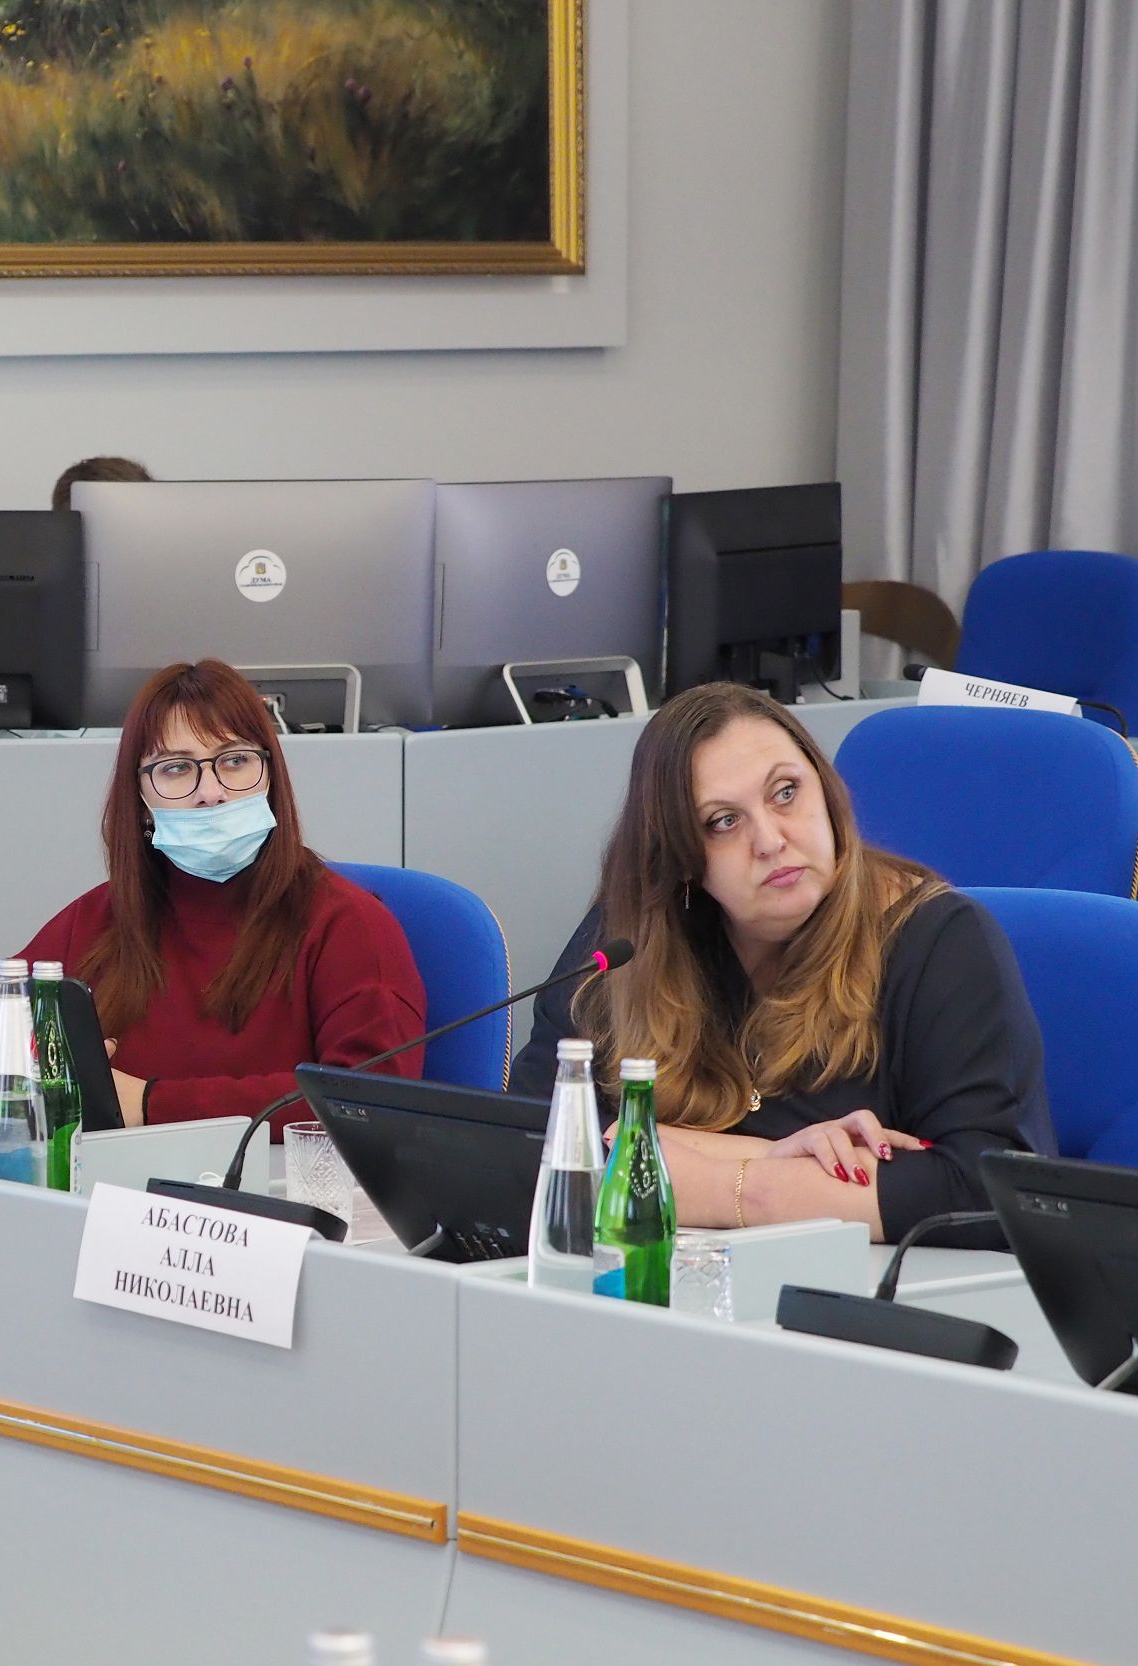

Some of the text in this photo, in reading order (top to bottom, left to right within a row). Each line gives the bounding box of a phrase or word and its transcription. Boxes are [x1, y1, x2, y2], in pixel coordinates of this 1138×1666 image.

[965, 682, 1030, 708] ЧЕРНЯЕВ
[141, 1206, 249, 1248] АБАСТОВА
[159, 1246, 215, 1277] АЛЛА
[114, 1270, 254, 1323] НИКОЛАЕВНА
